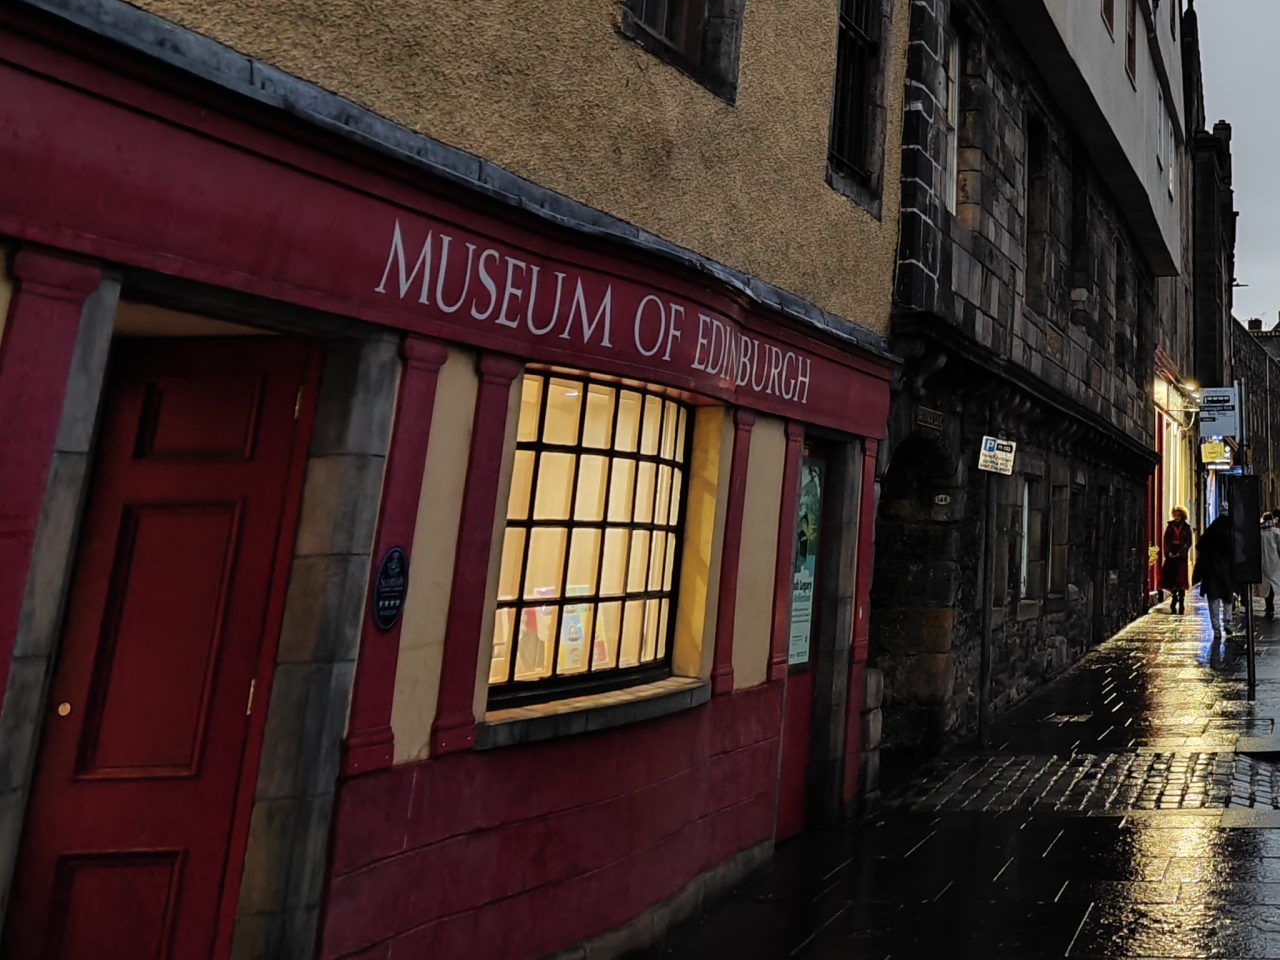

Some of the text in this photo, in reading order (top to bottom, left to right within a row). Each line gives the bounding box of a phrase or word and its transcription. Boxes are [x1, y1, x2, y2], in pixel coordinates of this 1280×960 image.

[374, 217, 812, 404] MUSEUM OF EDINBURGH
[986, 439, 995, 451] P
